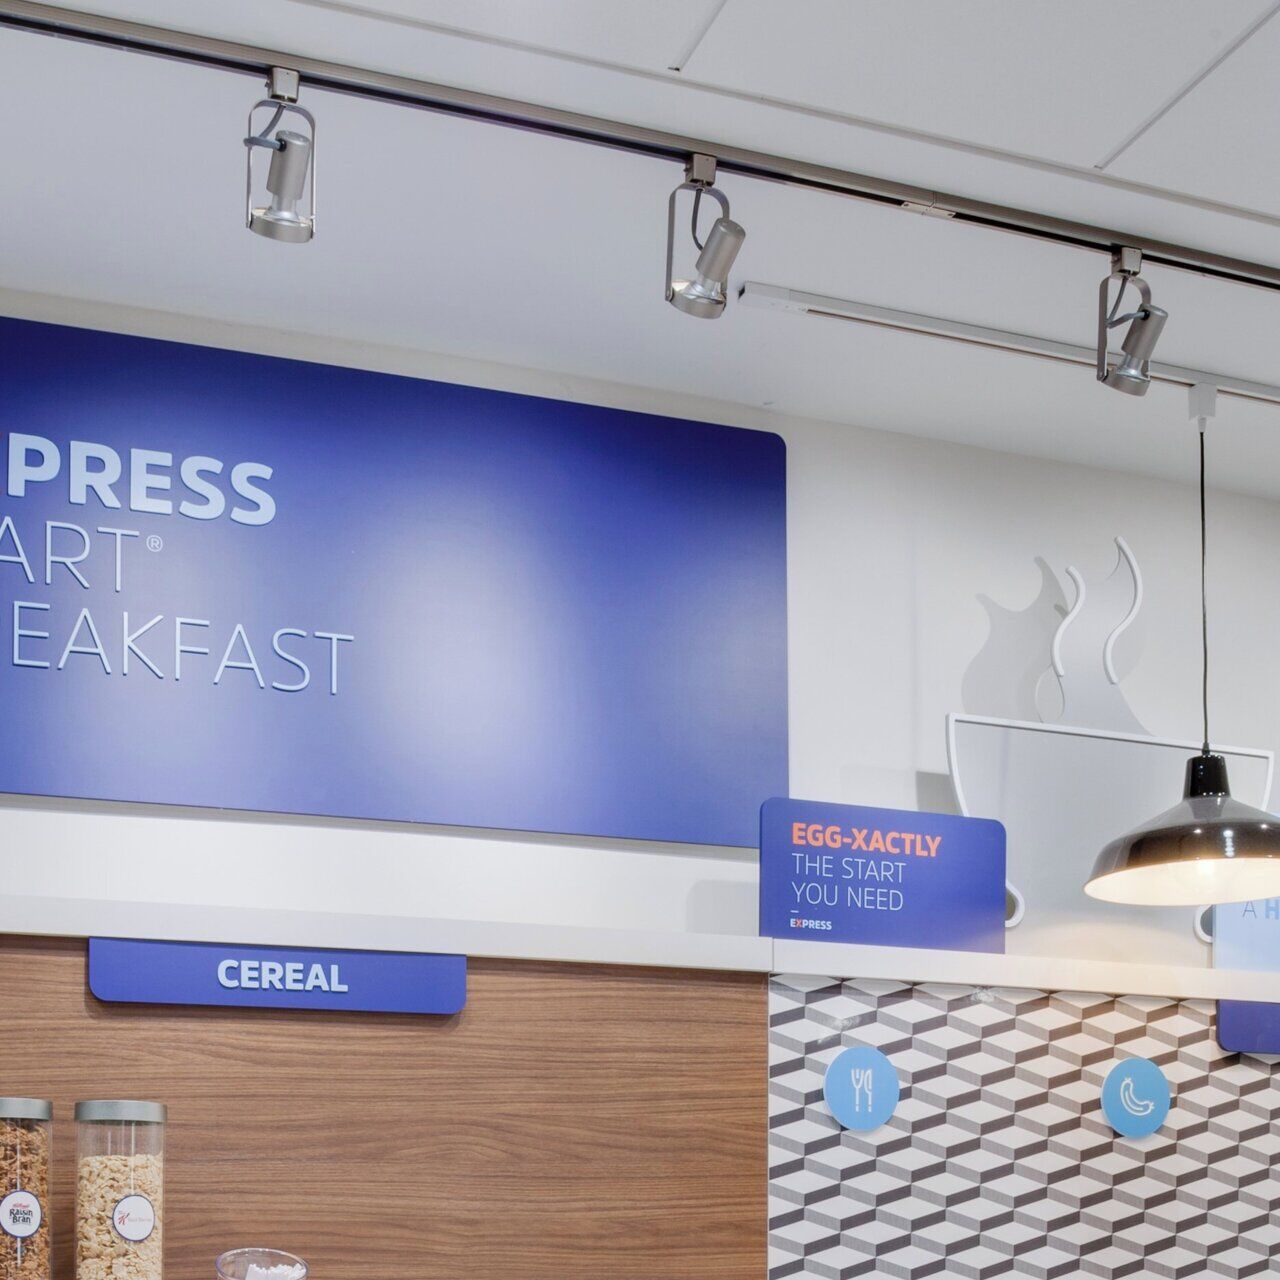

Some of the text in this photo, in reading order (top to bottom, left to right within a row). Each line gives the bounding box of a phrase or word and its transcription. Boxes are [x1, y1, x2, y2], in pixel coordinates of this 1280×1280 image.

[791, 822, 942, 857] EGG-XACTLY
[791, 853, 907, 884] THE START
[791, 882, 904, 911] YOU NEED
[1242, 900, 1257, 919] A
[790, 918, 832, 930] EXPRESS
[217, 959, 349, 994] CEREAL
[12, 1215, 31, 1223] Bran
